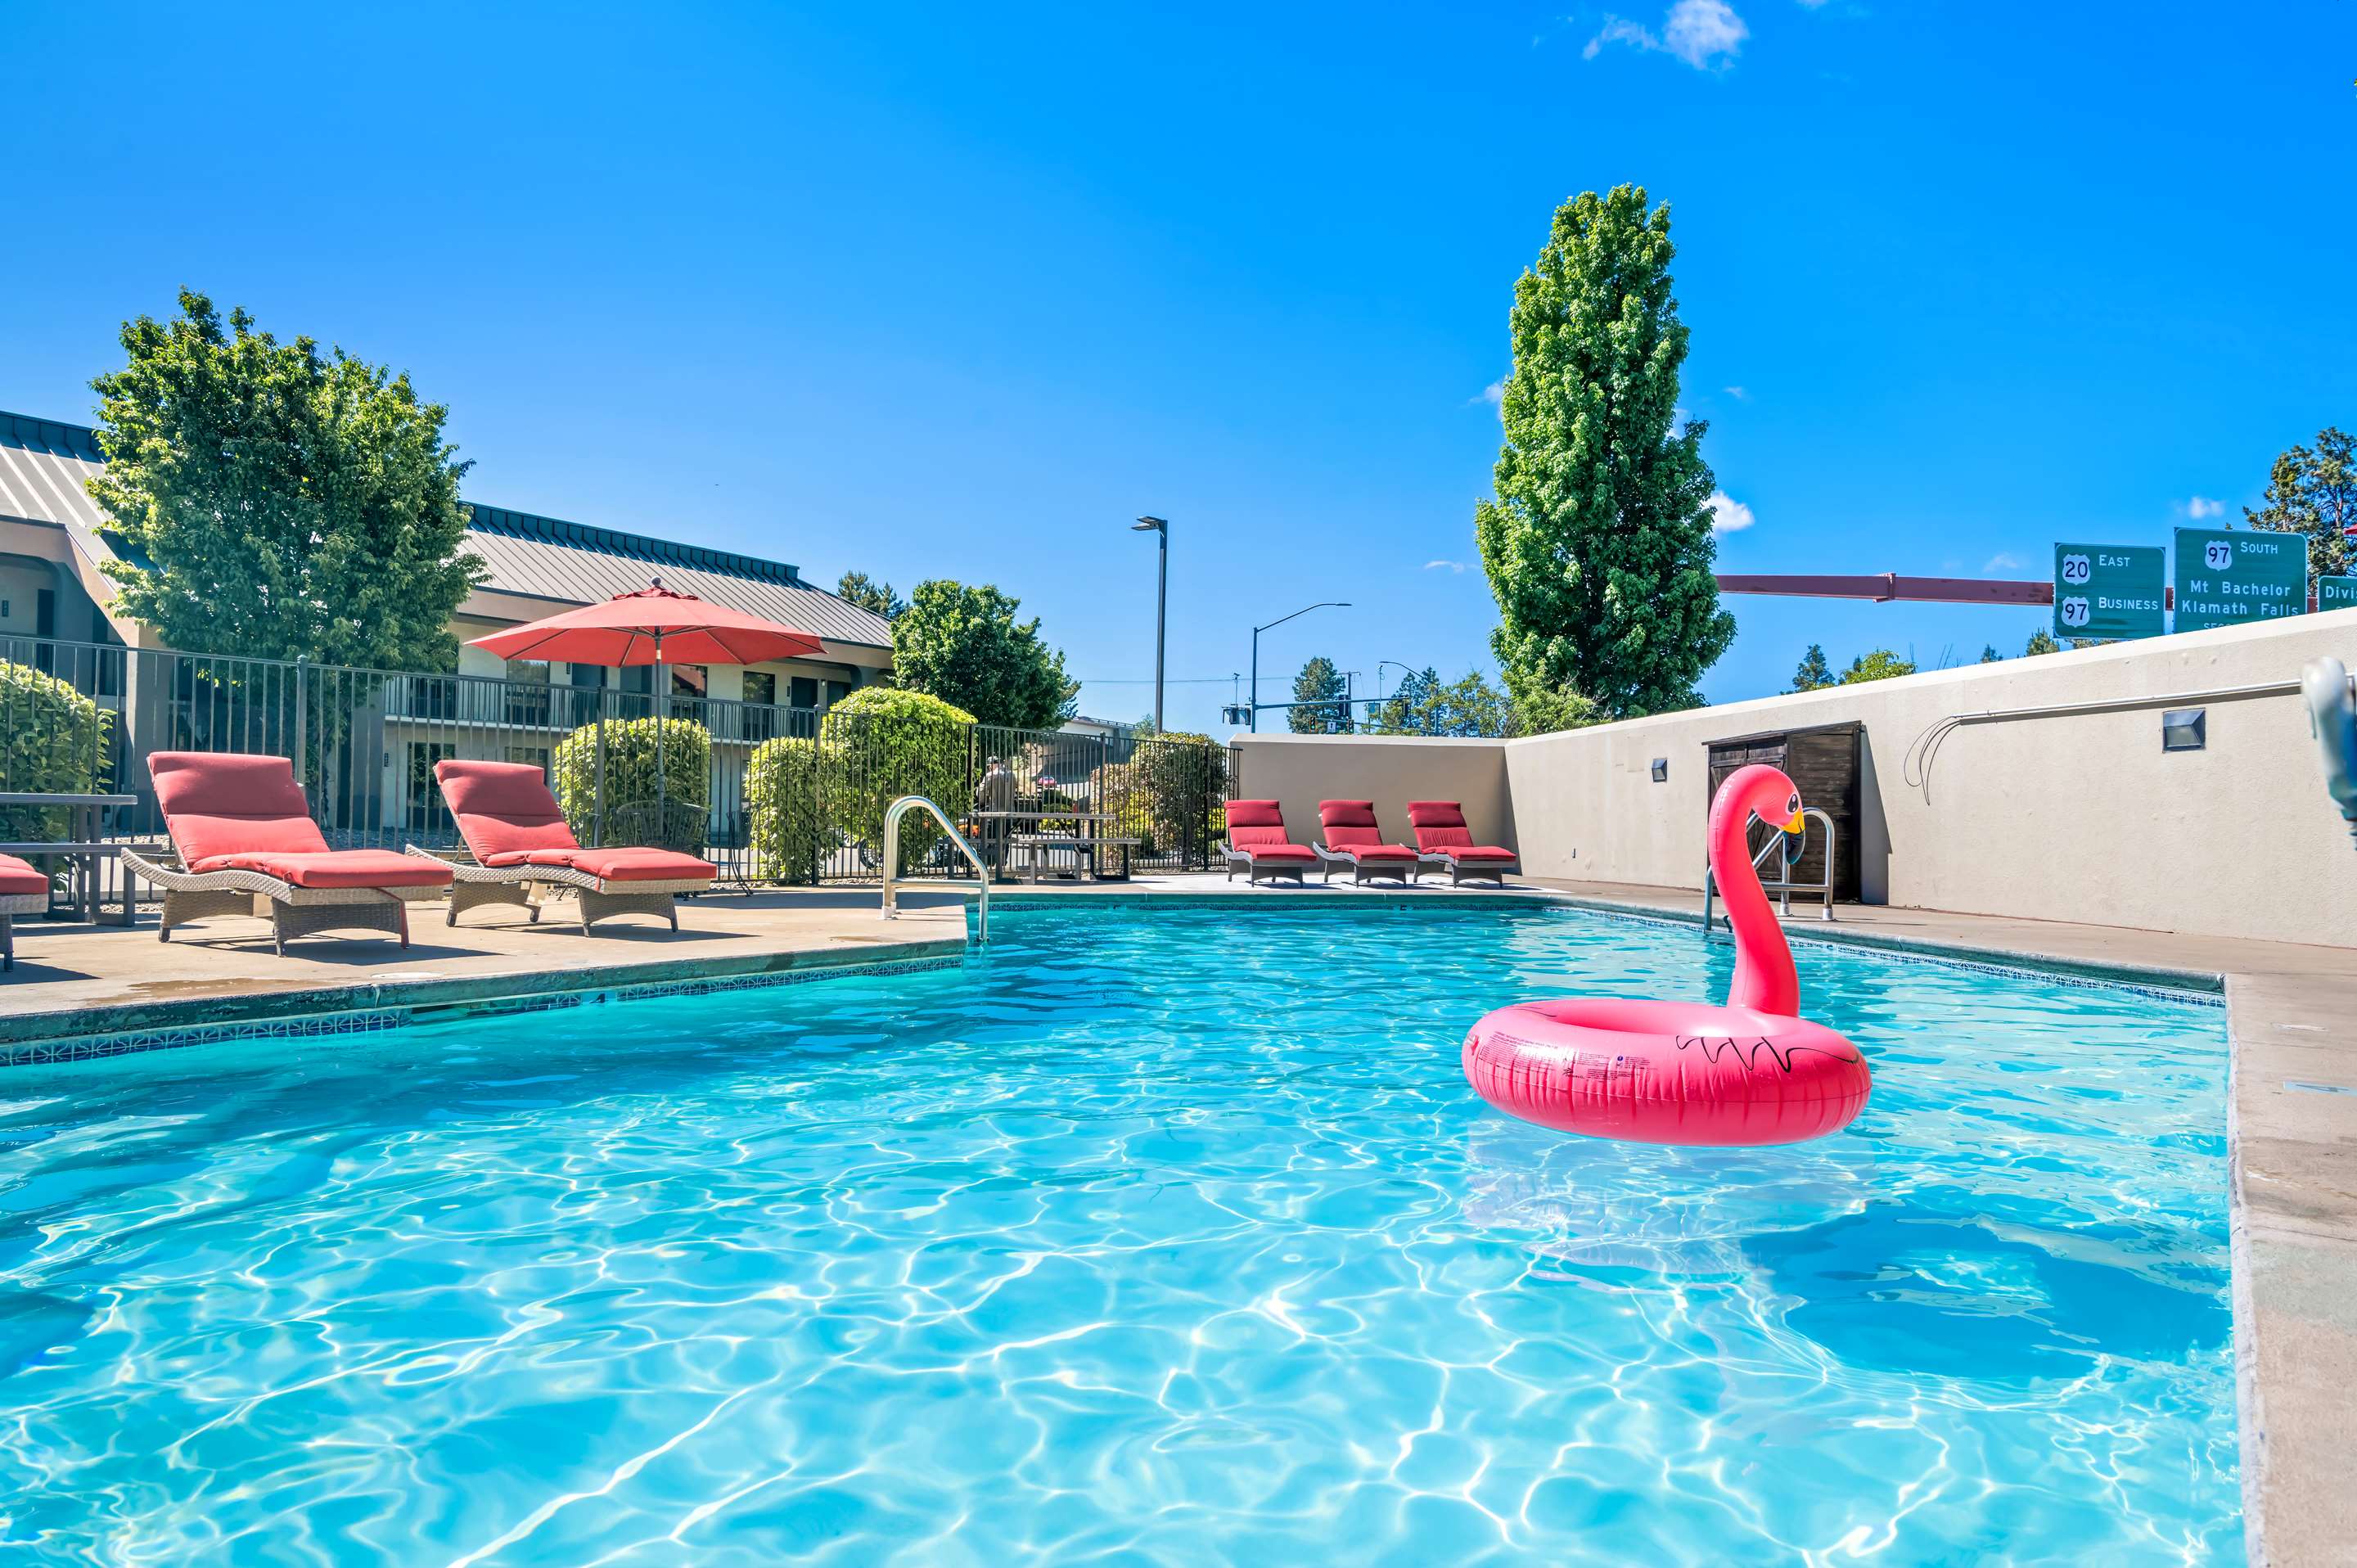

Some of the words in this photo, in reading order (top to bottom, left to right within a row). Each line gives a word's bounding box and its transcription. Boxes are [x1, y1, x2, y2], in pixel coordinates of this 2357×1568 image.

[2208, 547, 2229, 564] 97
[2240, 542, 2278, 554] SOUTH
[2065, 561, 2089, 578] 20
[2098, 554, 2130, 566] EAST
[2190, 580, 2209, 593] Mt
[2222, 581, 2291, 597] Bachelor
[2065, 603, 2088, 620] 97
[2098, 597, 2159, 610] BUSINESS
[2182, 600, 2247, 615] Klamath
[2260, 603, 2299, 616] Falls
